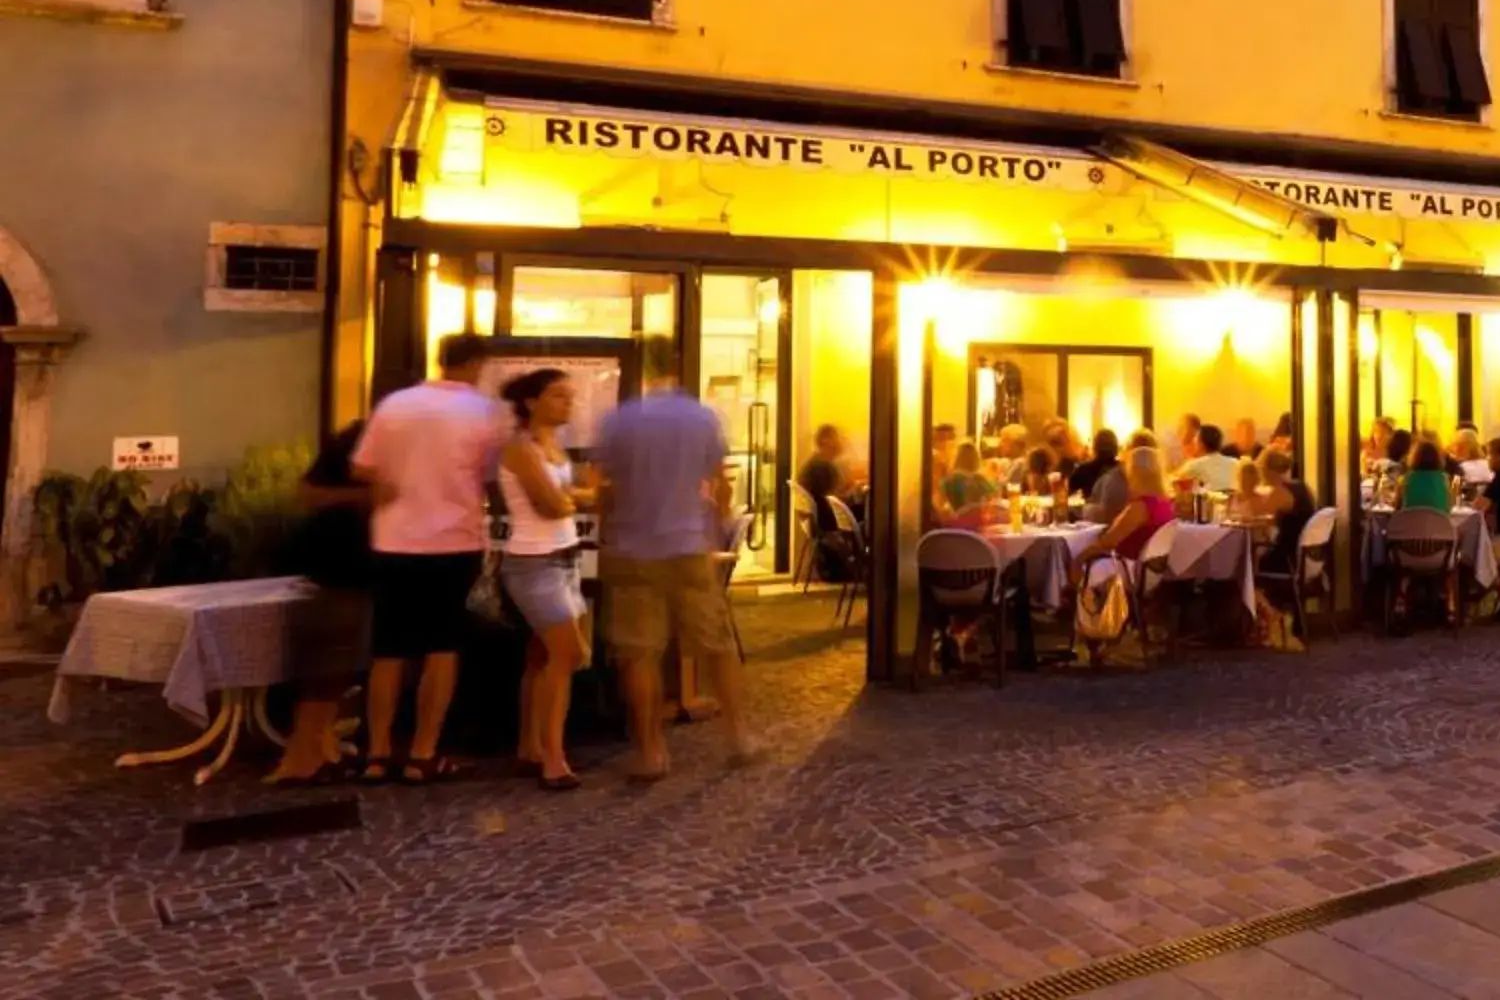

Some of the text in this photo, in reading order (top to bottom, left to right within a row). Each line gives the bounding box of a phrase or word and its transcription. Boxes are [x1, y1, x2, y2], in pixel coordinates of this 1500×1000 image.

[545, 118, 1062, 181] RISTORANTE "AL PORTO"
[1410, 193, 1454, 216] "AL
